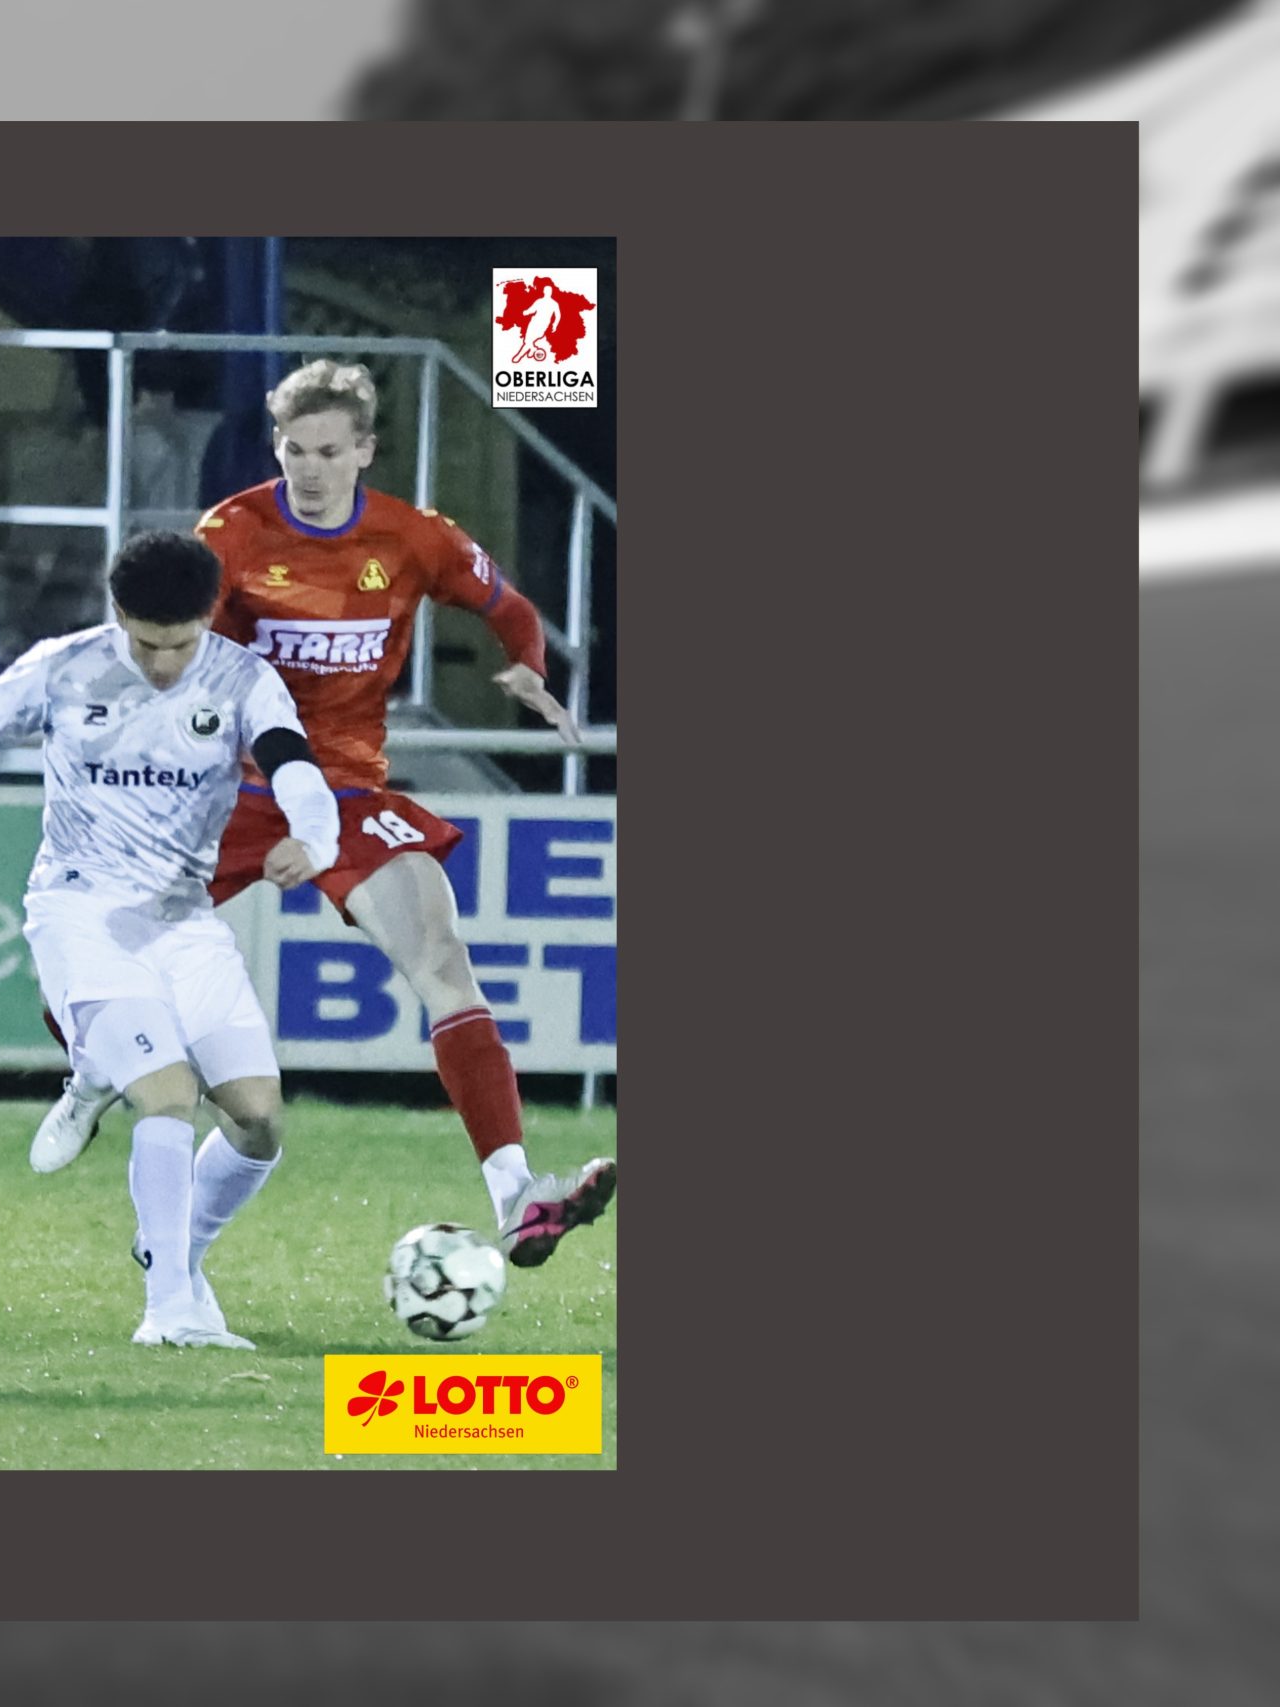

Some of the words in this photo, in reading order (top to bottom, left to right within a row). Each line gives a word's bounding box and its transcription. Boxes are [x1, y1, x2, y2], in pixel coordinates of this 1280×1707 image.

[248, 618, 392, 664] STARK
[362, 810, 425, 849] 18
[135, 1033, 154, 1054] 9
